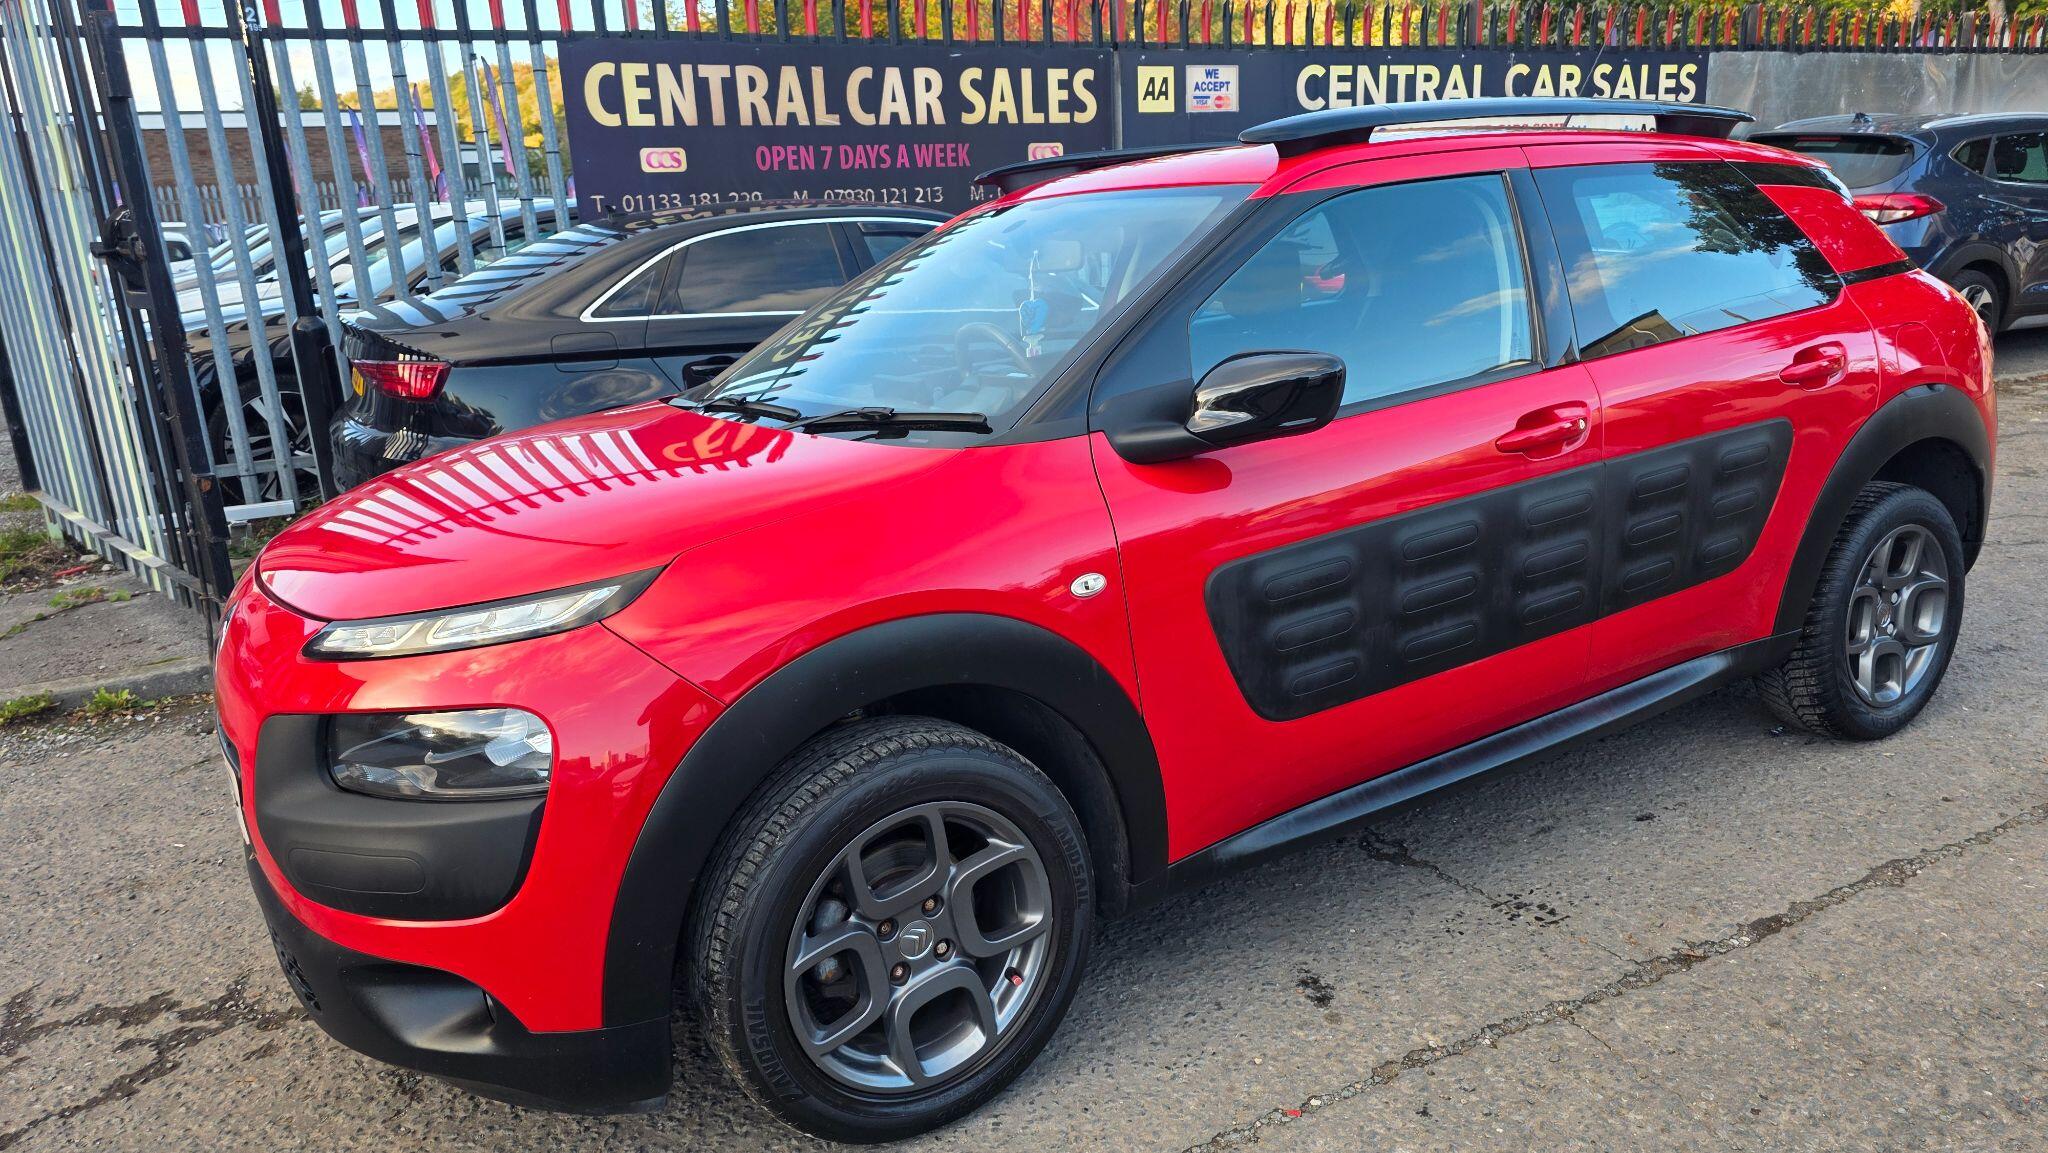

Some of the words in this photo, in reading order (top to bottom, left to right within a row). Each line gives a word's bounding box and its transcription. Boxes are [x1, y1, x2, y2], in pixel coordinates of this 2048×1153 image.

[1205, 69, 1219, 79] WE
[1504, 63, 1582, 97] CAR
[1592, 63, 1698, 103] SALES
[584, 62, 841, 127] CENTRAL
[846, 66, 946, 126] CAR
[959, 67, 1098, 125] SALES
[1143, 77, 1168, 101] AA
[1194, 81, 1231, 92] ACCEPT
[645, 151, 682, 168] CCS
[755, 145, 815, 171] OPEN
[820, 146, 833, 169] 7
[839, 144, 892, 170] DAYS
[896, 144, 910, 168] A
[913, 143, 971, 168] WEEK
[622, 193, 682, 213] 01133
[881, 188, 907, 204] 121
[914, 187, 944, 203] 213
